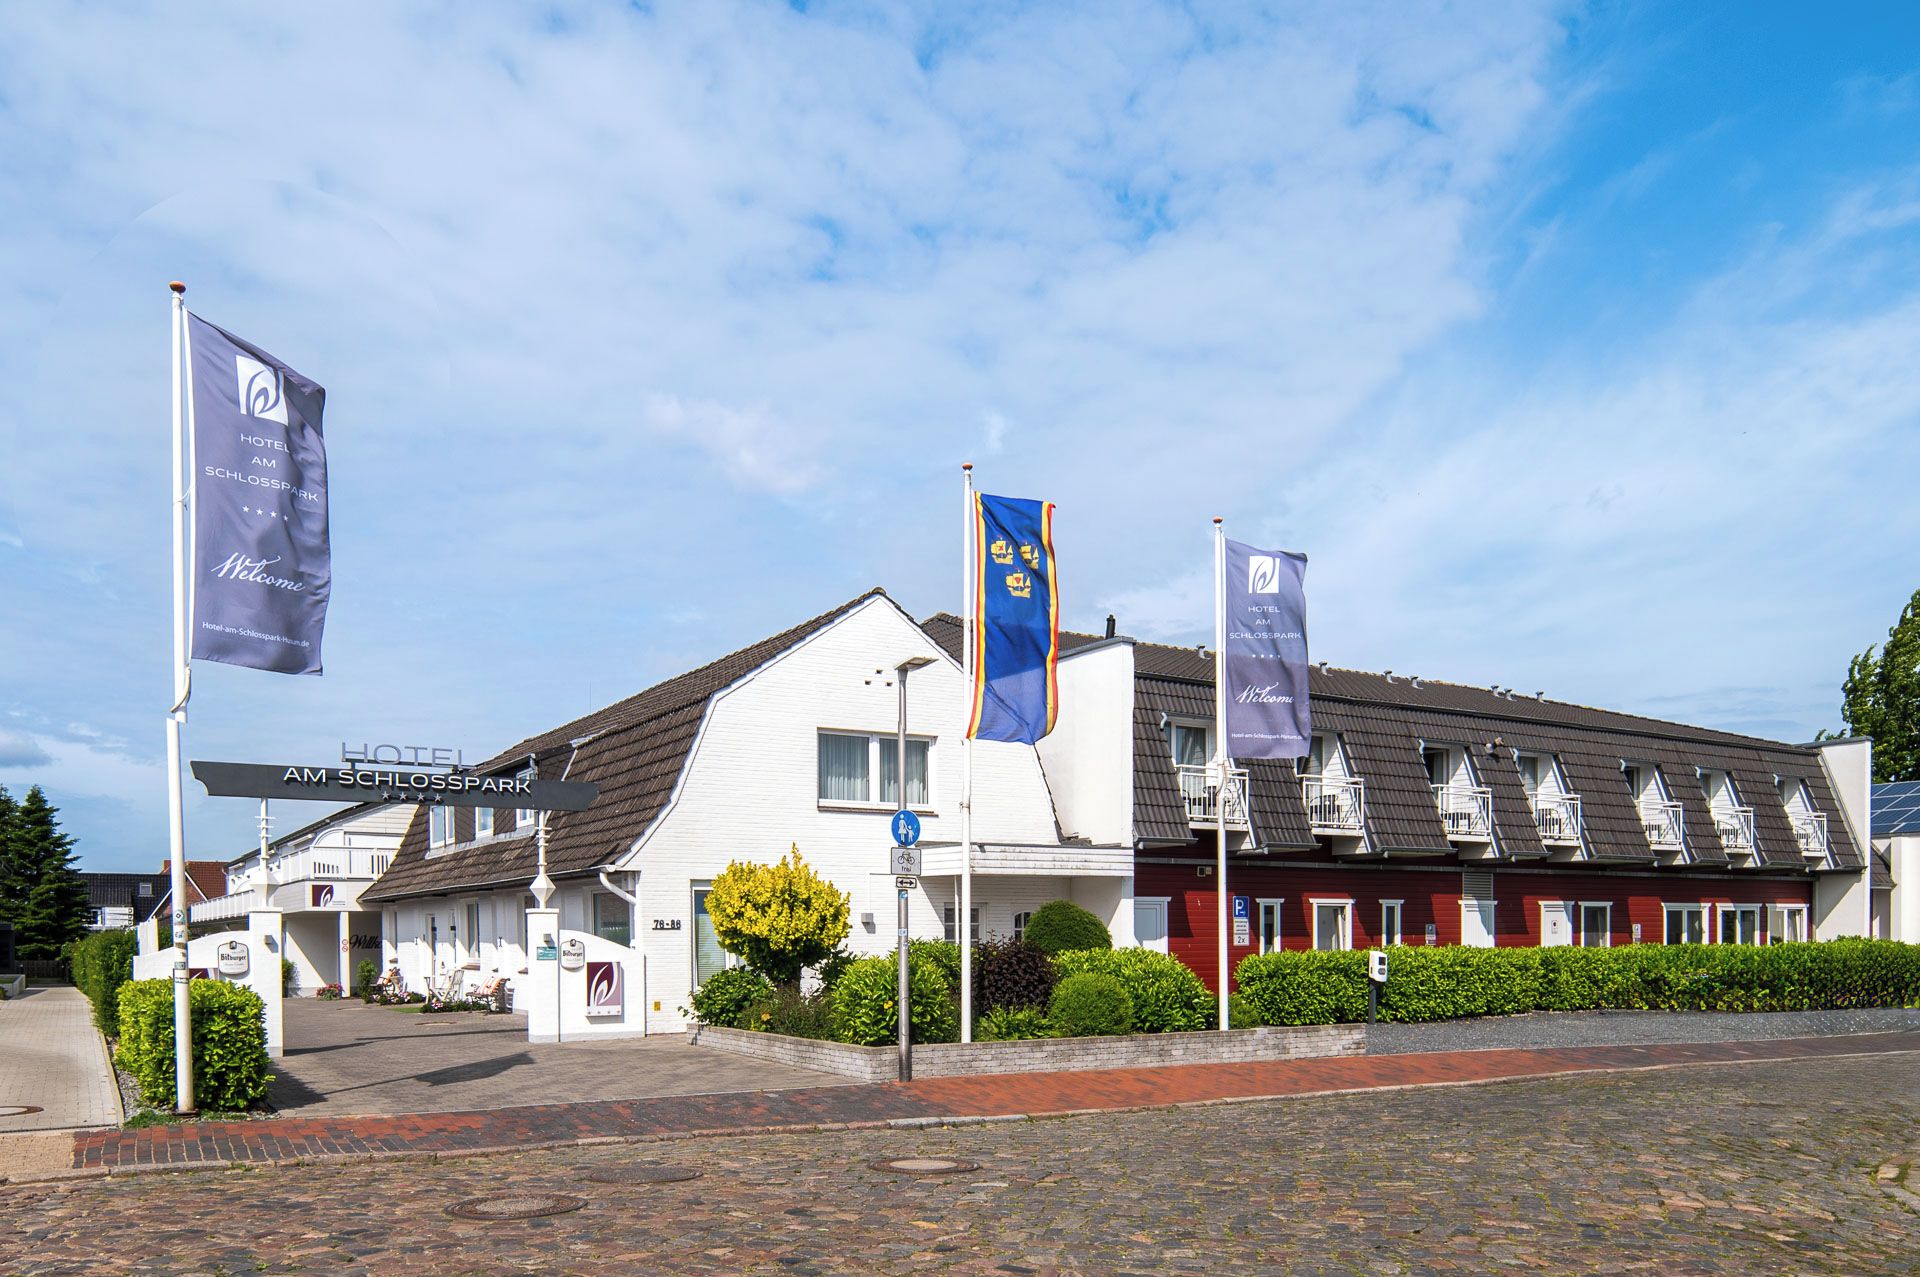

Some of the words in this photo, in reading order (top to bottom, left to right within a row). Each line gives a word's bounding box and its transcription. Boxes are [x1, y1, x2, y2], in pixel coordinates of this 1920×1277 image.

[240, 433, 290, 453] HOTEL
[251, 456, 276, 468] AM
[205, 466, 319, 502] SCHLOSSPARK
[211, 552, 306, 592] Welcome
[1247, 605, 1281, 613] HOTEL
[341, 742, 476, 771] HOTEL
[283, 767, 327, 784] AM
[338, 769, 532, 794] SCHLOSSPARK
[220, 953, 247, 962] Bitburger
